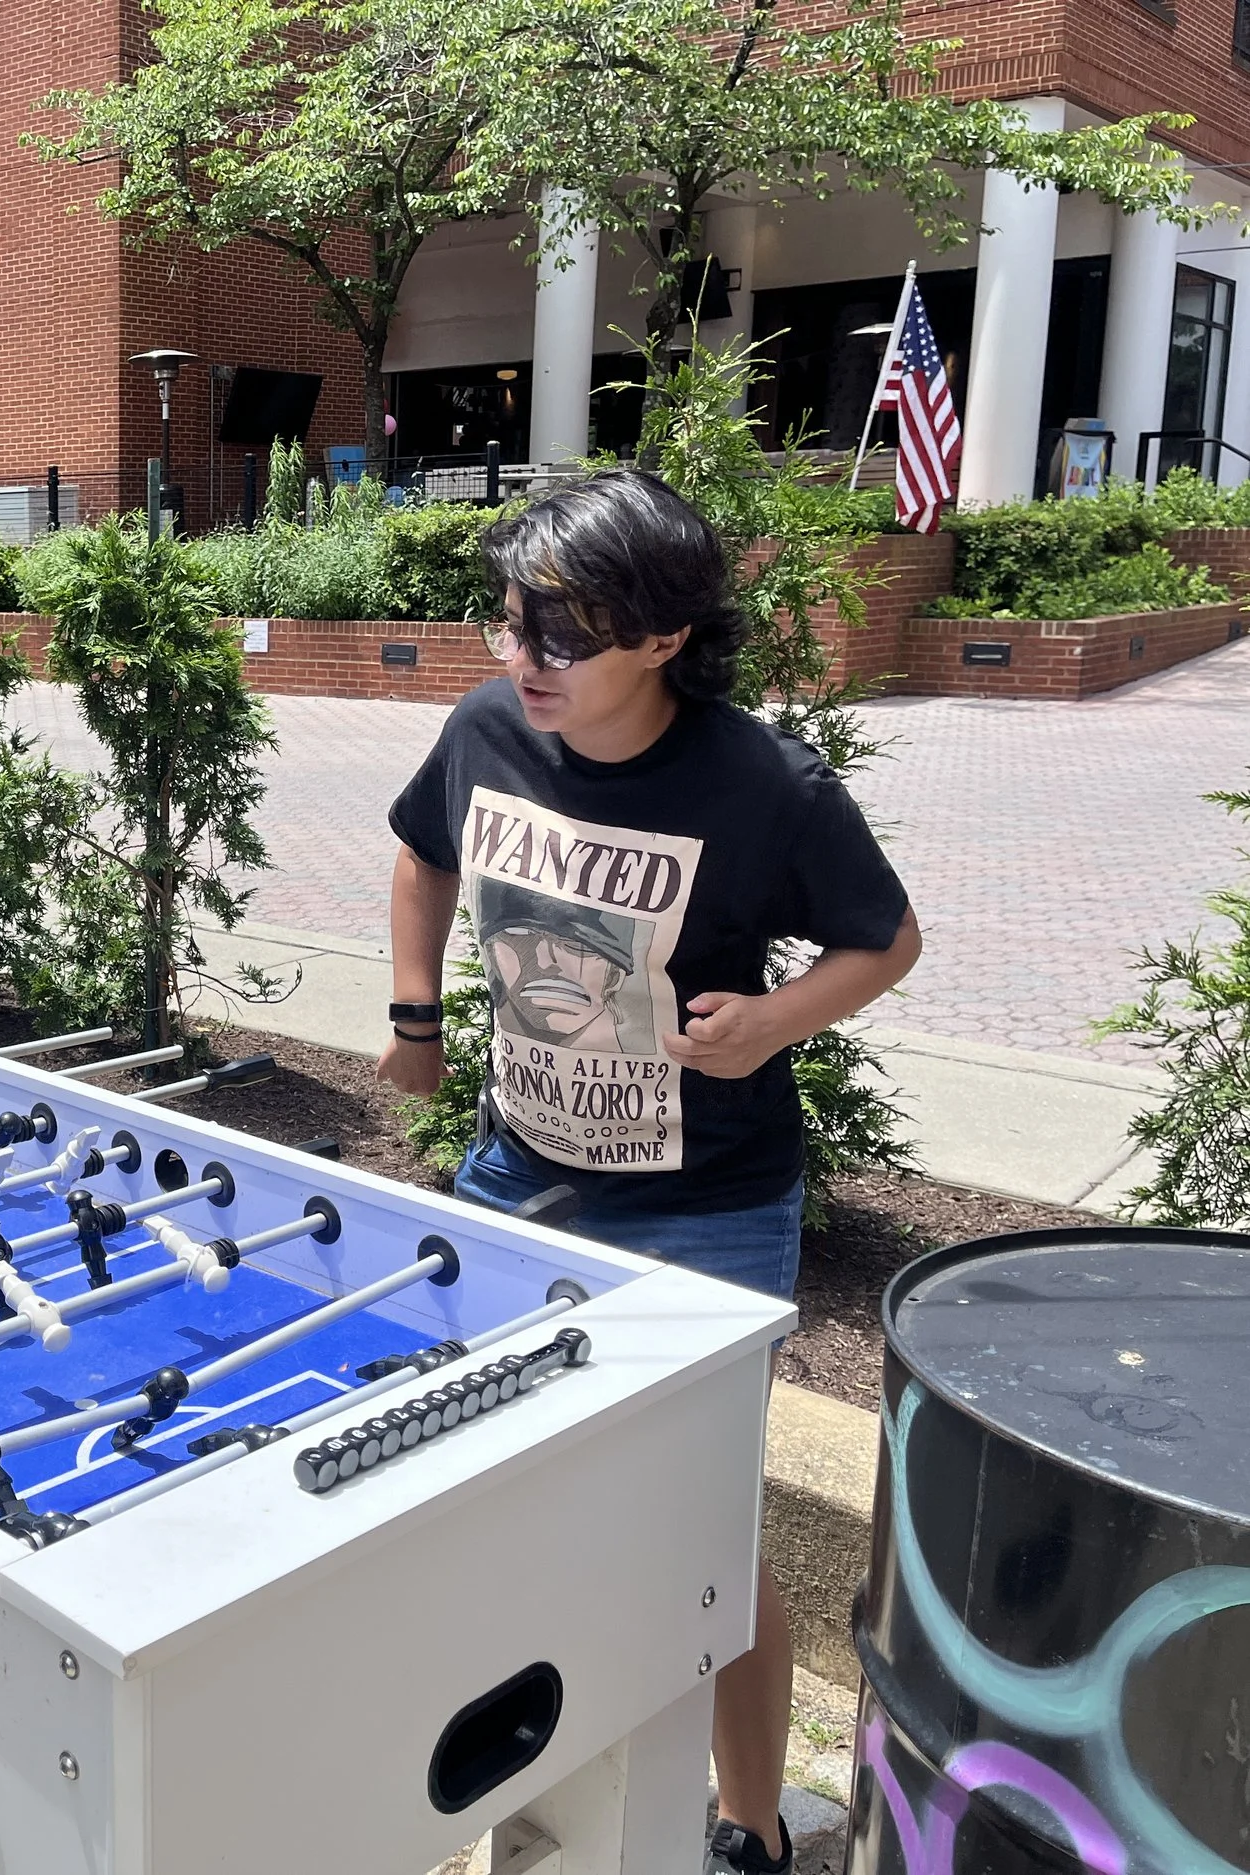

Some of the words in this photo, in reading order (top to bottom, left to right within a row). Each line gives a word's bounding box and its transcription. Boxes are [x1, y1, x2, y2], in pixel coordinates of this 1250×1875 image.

[471, 805, 682, 914] WANTED
[529, 1046, 556, 1071] OR
[573, 1057, 656, 1080] ALIVE
[500, 1055, 567, 1113] RONOA
[571, 1080, 644, 1122] ZORO
[585, 1141, 665, 1165] MARINE
[506, 1356, 523, 1364] 1
[487, 1365, 505, 1373] 2
[450, 1383, 465, 1392] 4
[432, 1392, 448, 1401] 5
[393, 1410, 410, 1420] 7
[371, 1420, 388, 1430] 8
[351, 1429, 368, 1439] 9
[327, 1438, 349, 1450] 10
